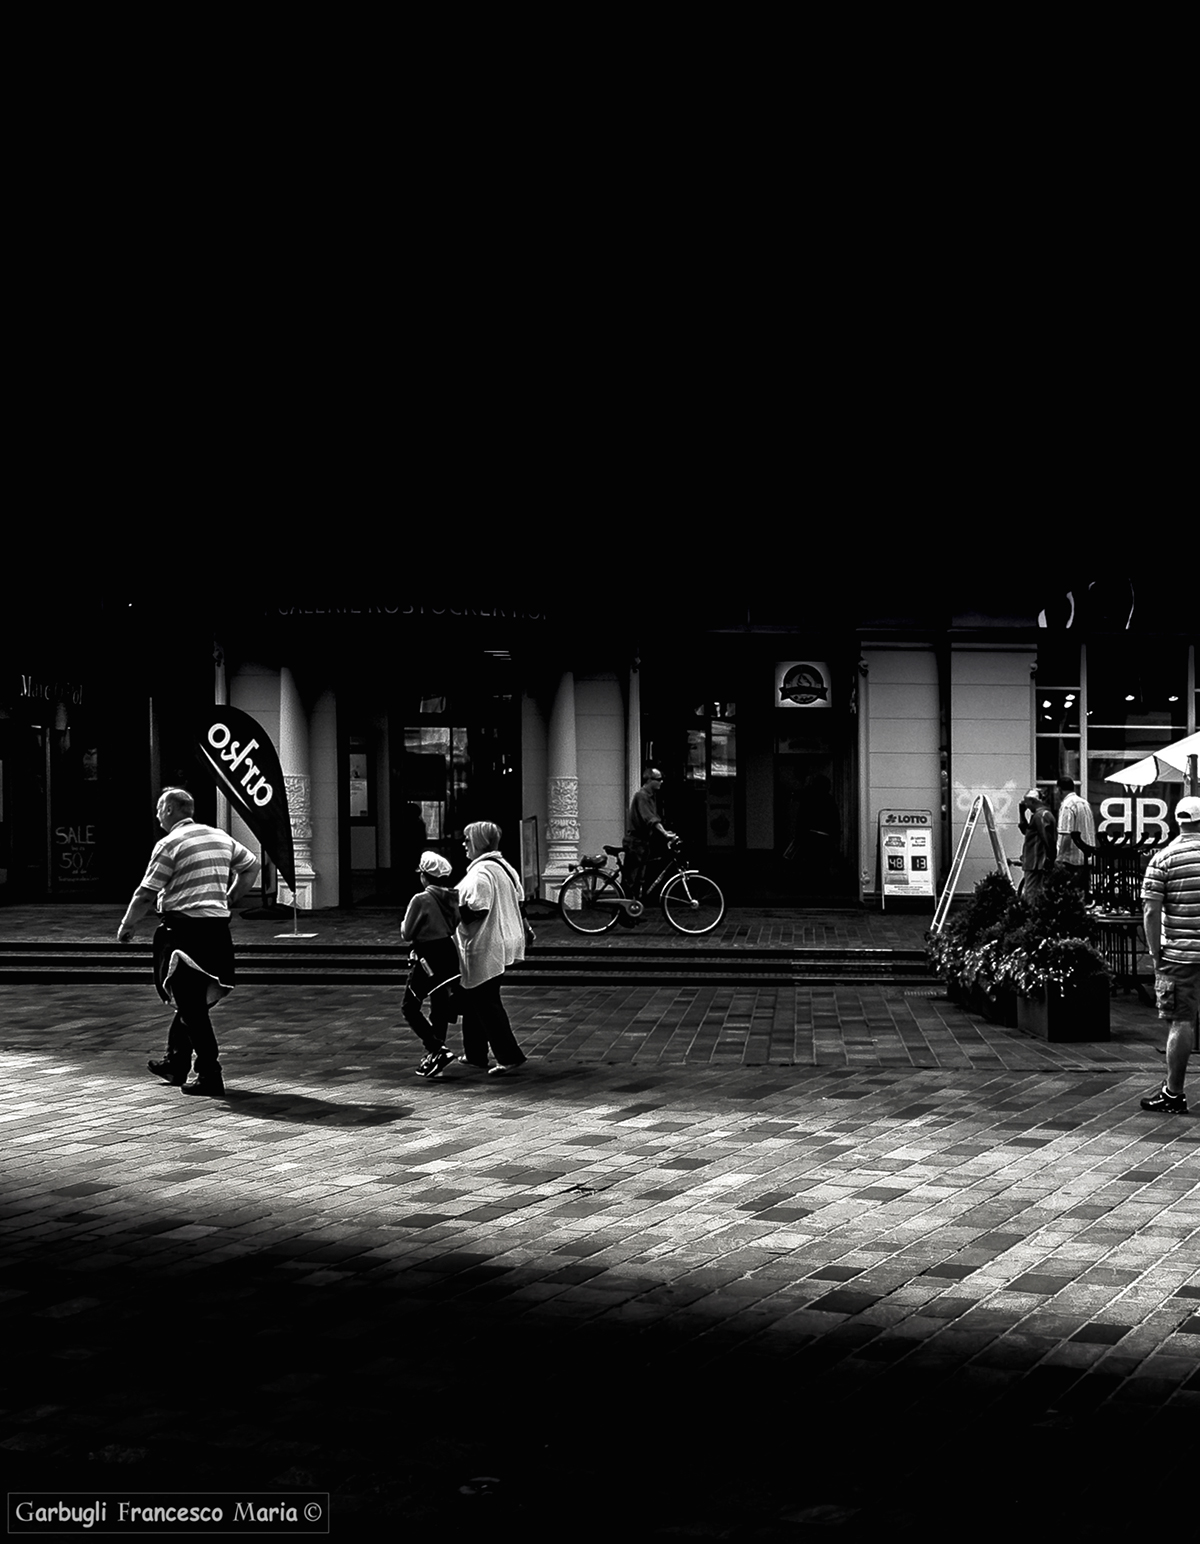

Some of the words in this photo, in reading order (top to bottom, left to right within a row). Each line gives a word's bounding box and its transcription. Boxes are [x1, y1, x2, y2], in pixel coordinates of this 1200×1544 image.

[898, 815, 928, 824] LOTTO
[54, 824, 96, 845] SALE
[889, 857, 903, 869] 48
[916, 857, 926, 869] 13
